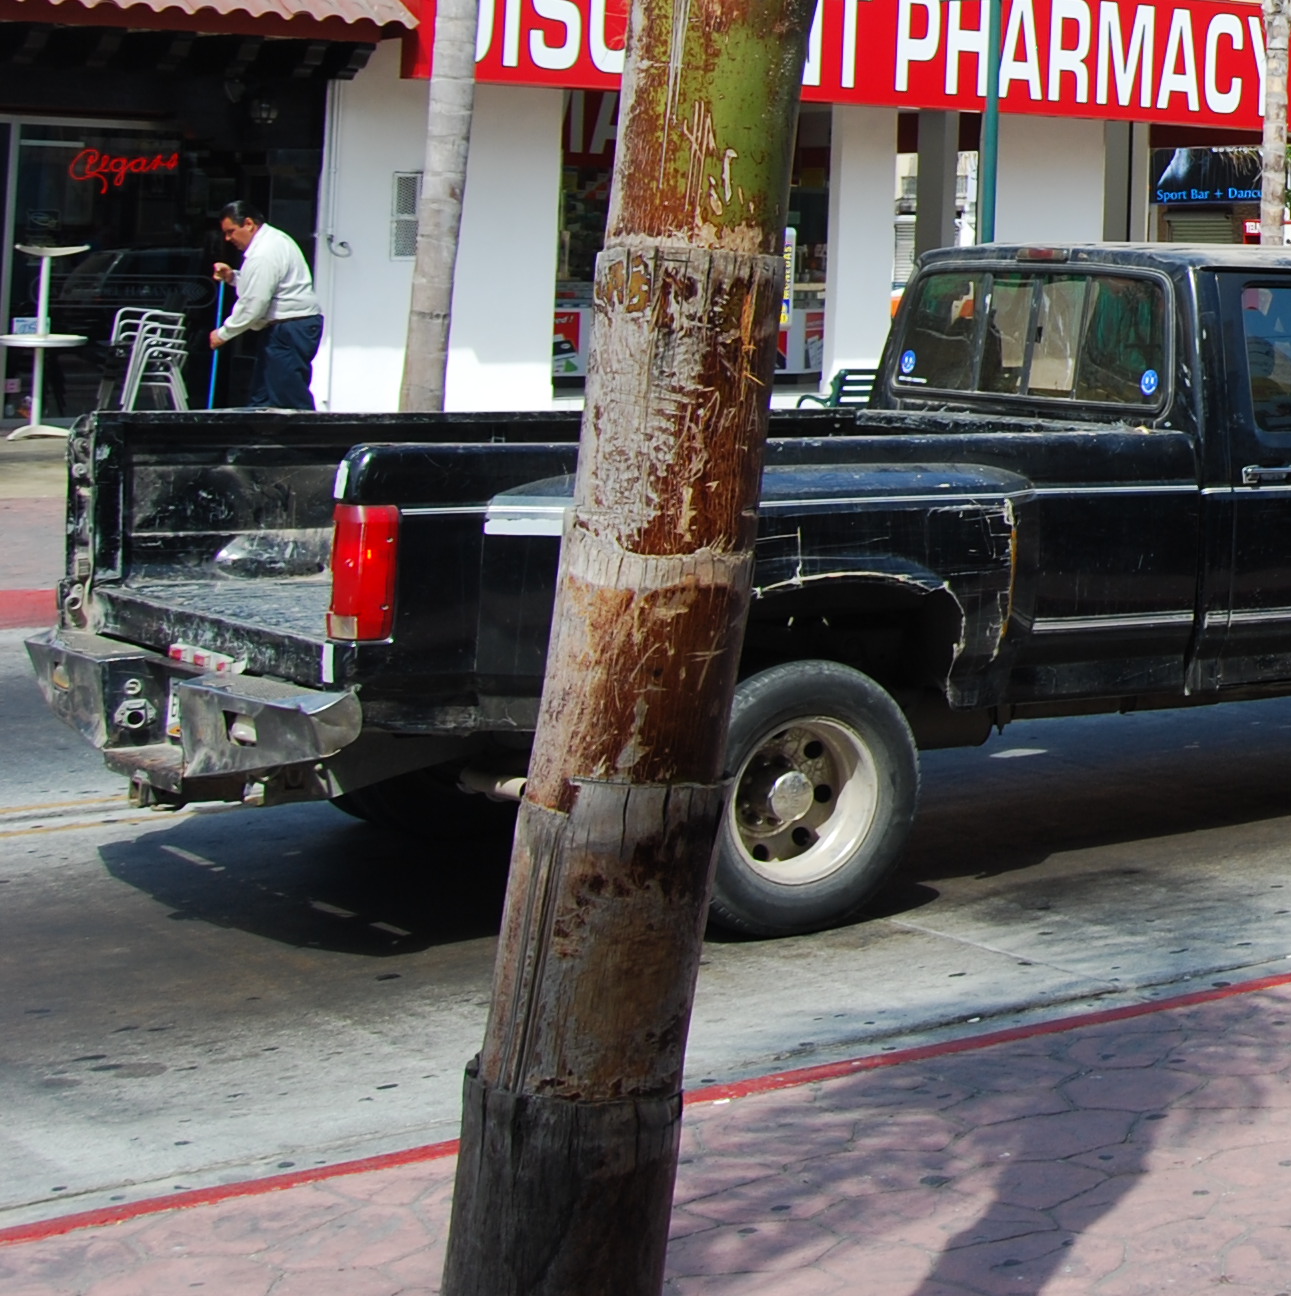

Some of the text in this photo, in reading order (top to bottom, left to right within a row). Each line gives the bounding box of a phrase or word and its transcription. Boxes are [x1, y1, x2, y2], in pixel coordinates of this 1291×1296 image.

[69, 149, 180, 195] Cigars
[1156, 189, 1187, 203] Sport
[1191, 188, 1210, 200] Bar
